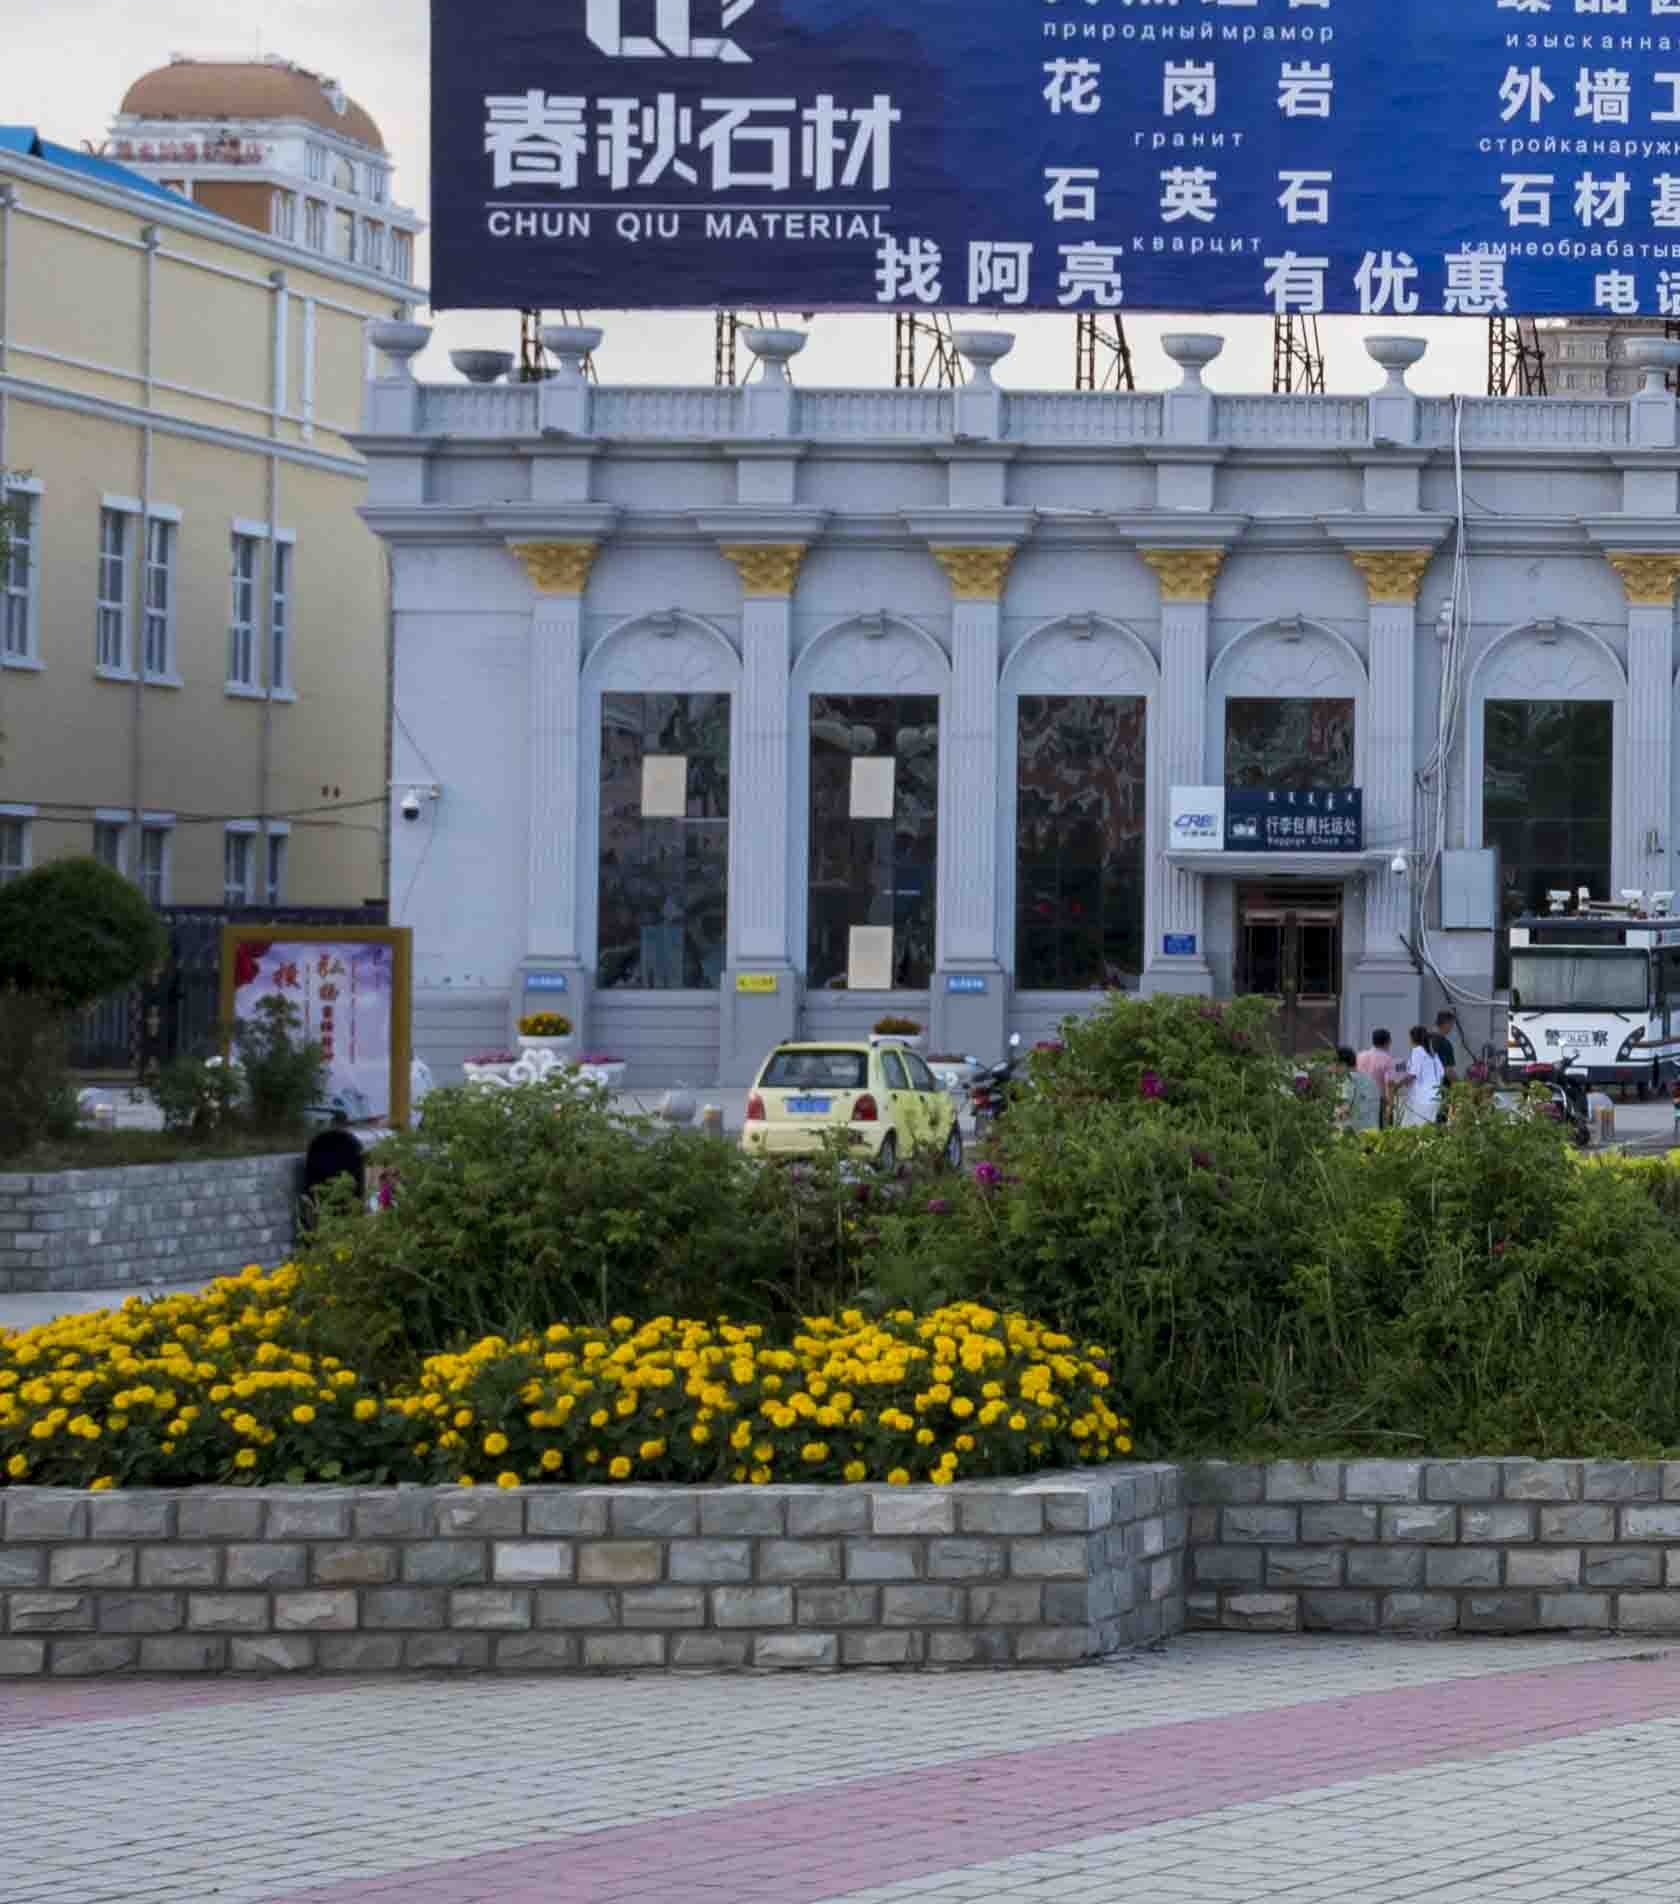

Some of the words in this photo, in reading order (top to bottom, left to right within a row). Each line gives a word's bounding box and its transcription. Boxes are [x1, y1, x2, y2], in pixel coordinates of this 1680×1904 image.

[1042, 57, 1334, 118] 花岗岩
[484, 89, 902, 191] 春秋石材
[1133, 131, 1245, 150] гранит
[1043, 165, 1333, 225] 石英石
[487, 211, 592, 238] CHUN
[615, 212, 681, 243] QIU
[705, 213, 891, 240] MATERIAL
[1132, 235, 1263, 254] кварцит
[875, 237, 1124, 306] 找阿亮
[1263, 251, 1508, 314] 有优惠
